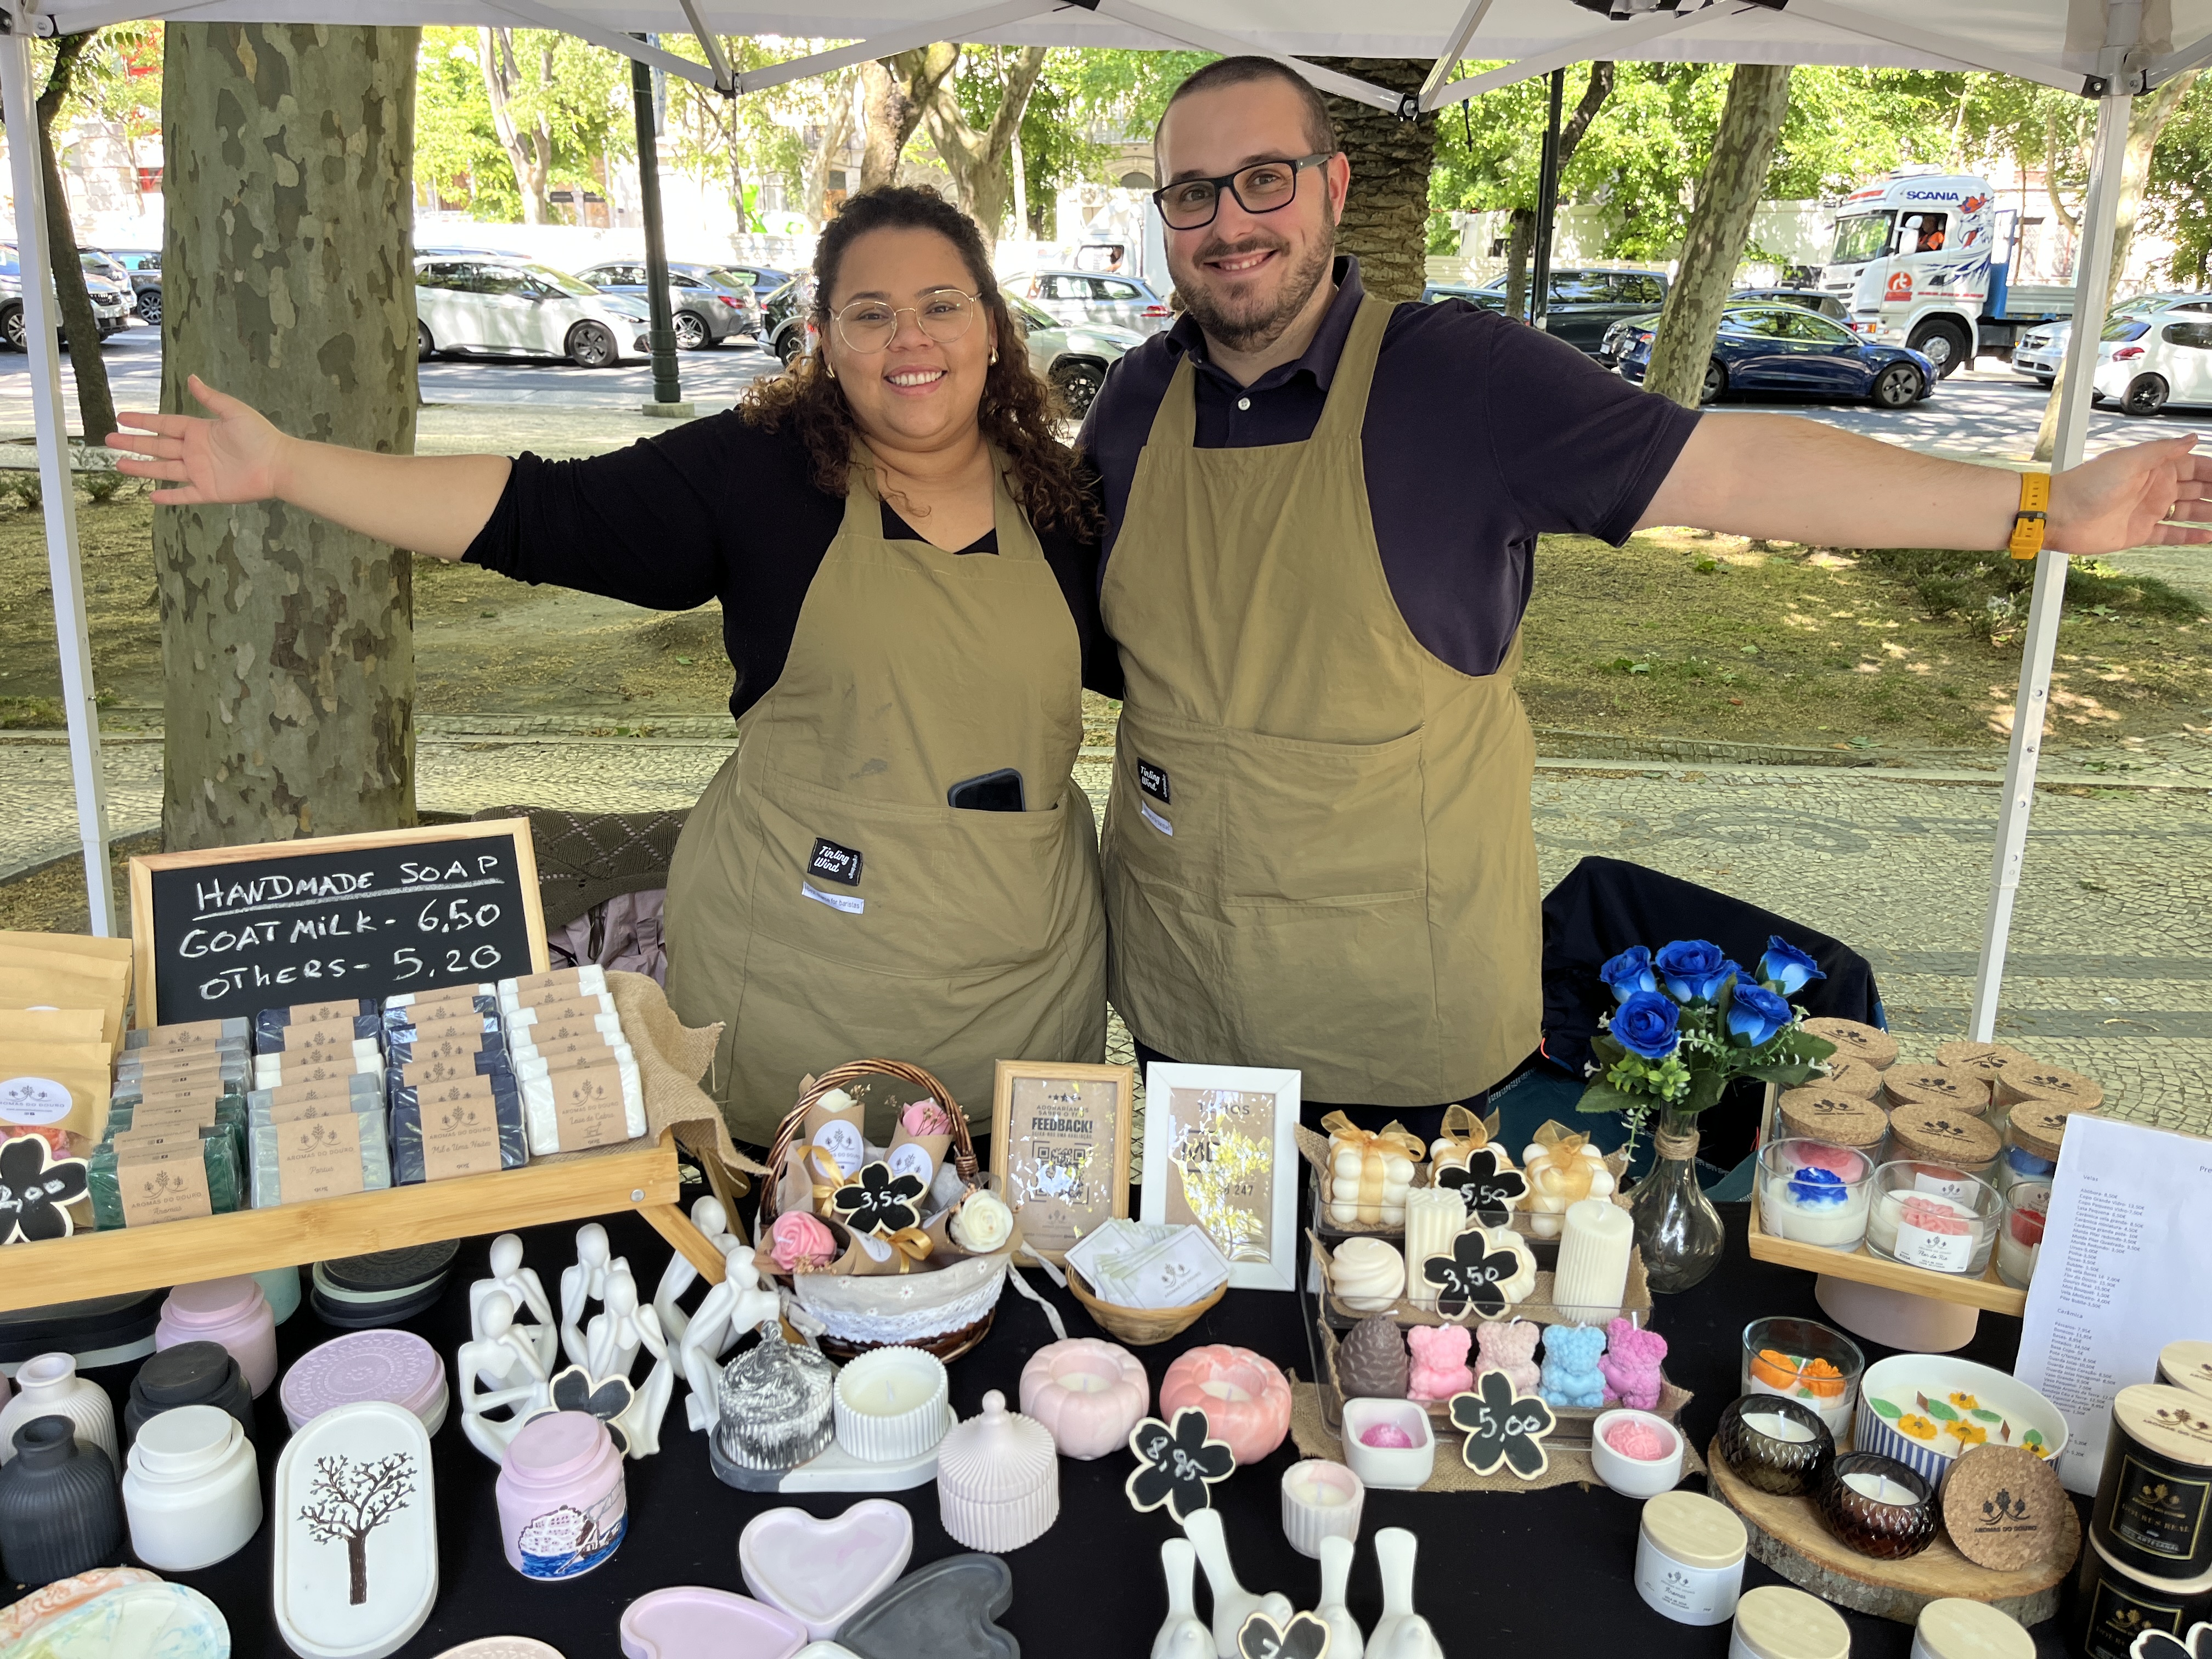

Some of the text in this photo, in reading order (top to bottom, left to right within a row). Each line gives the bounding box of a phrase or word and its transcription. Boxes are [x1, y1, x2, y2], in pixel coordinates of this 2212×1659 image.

[1906, 191, 1959, 201] SCANIA
[814, 856, 839, 873] Wind
[198, 855, 498, 911] HANDMADE SOAP
[838, 899, 860, 909] baristas
[179, 921, 281, 958] GOAT
[1032, 1117, 1093, 1133] FEEDBACK!
[430, 1132, 456, 1140] AROMAS
[432, 1144, 445, 1154] Mil
[286, 1153, 315, 1161] AROMAS
[1235, 1185, 1254, 1196] 247
[1460, 1183, 1509, 1206] 5,50
[131, 1199, 161, 1209] AROMAS
[860, 1190, 908, 1212] 3,50
[1443, 1266, 1499, 1294] 3,50
[2057, 1308, 2083, 1318] Cerâmica
[1479, 1407, 1541, 1443] 5,00
